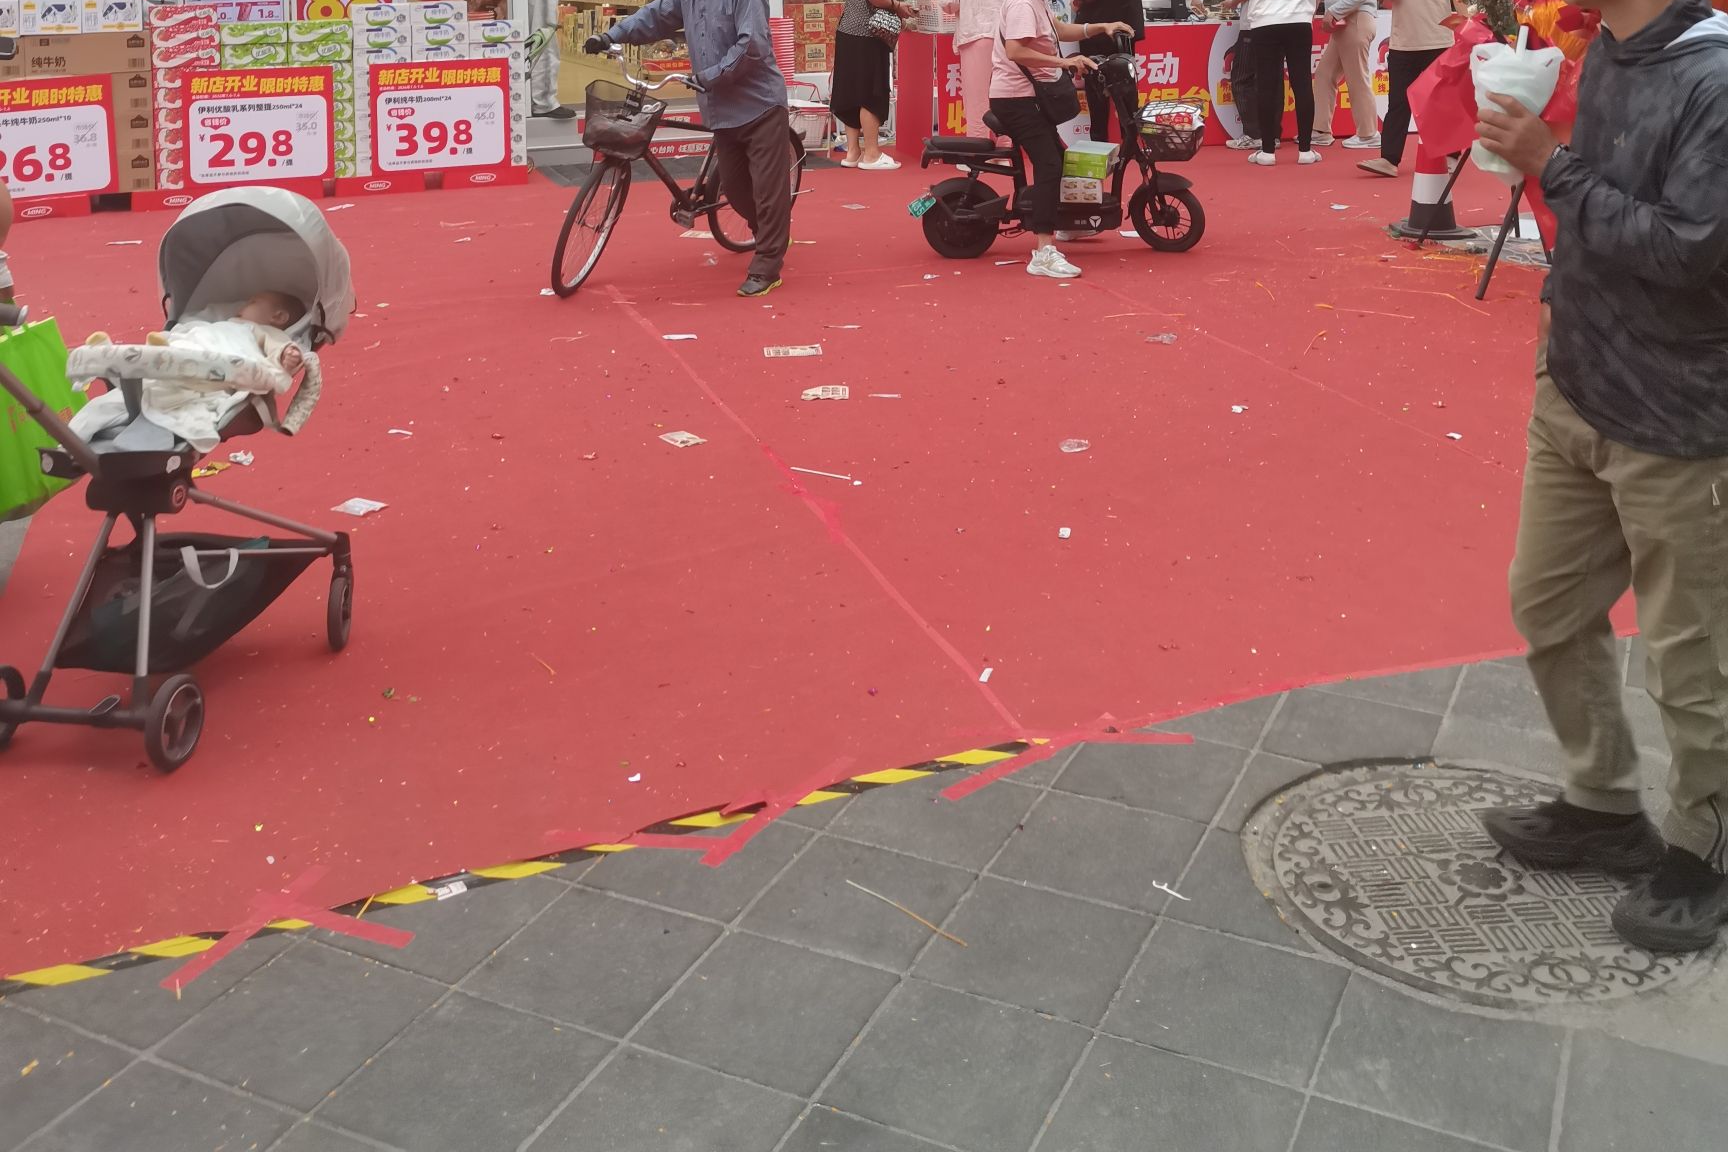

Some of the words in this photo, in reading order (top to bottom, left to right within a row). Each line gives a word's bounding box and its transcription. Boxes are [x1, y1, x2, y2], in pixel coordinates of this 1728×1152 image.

[258, 9, 274, 18] 1.8
[31, 56, 66, 68] 纯牛奶
[378, 67, 440, 85] 新店开业
[441, 67, 501, 85] 限时特惠
[190, 75, 259, 94] 新店开业
[260, 75, 325, 94] 限时特惠
[32, 85, 103, 106] 限时特惠
[0, 115, 71, 128] 牛纯牛奶250ml10
[395, 119, 473, 157] 39.8
[208, 129, 293, 168] 29.8
[169, 197, 188, 205] MING
[26, 208, 46, 216] MING
